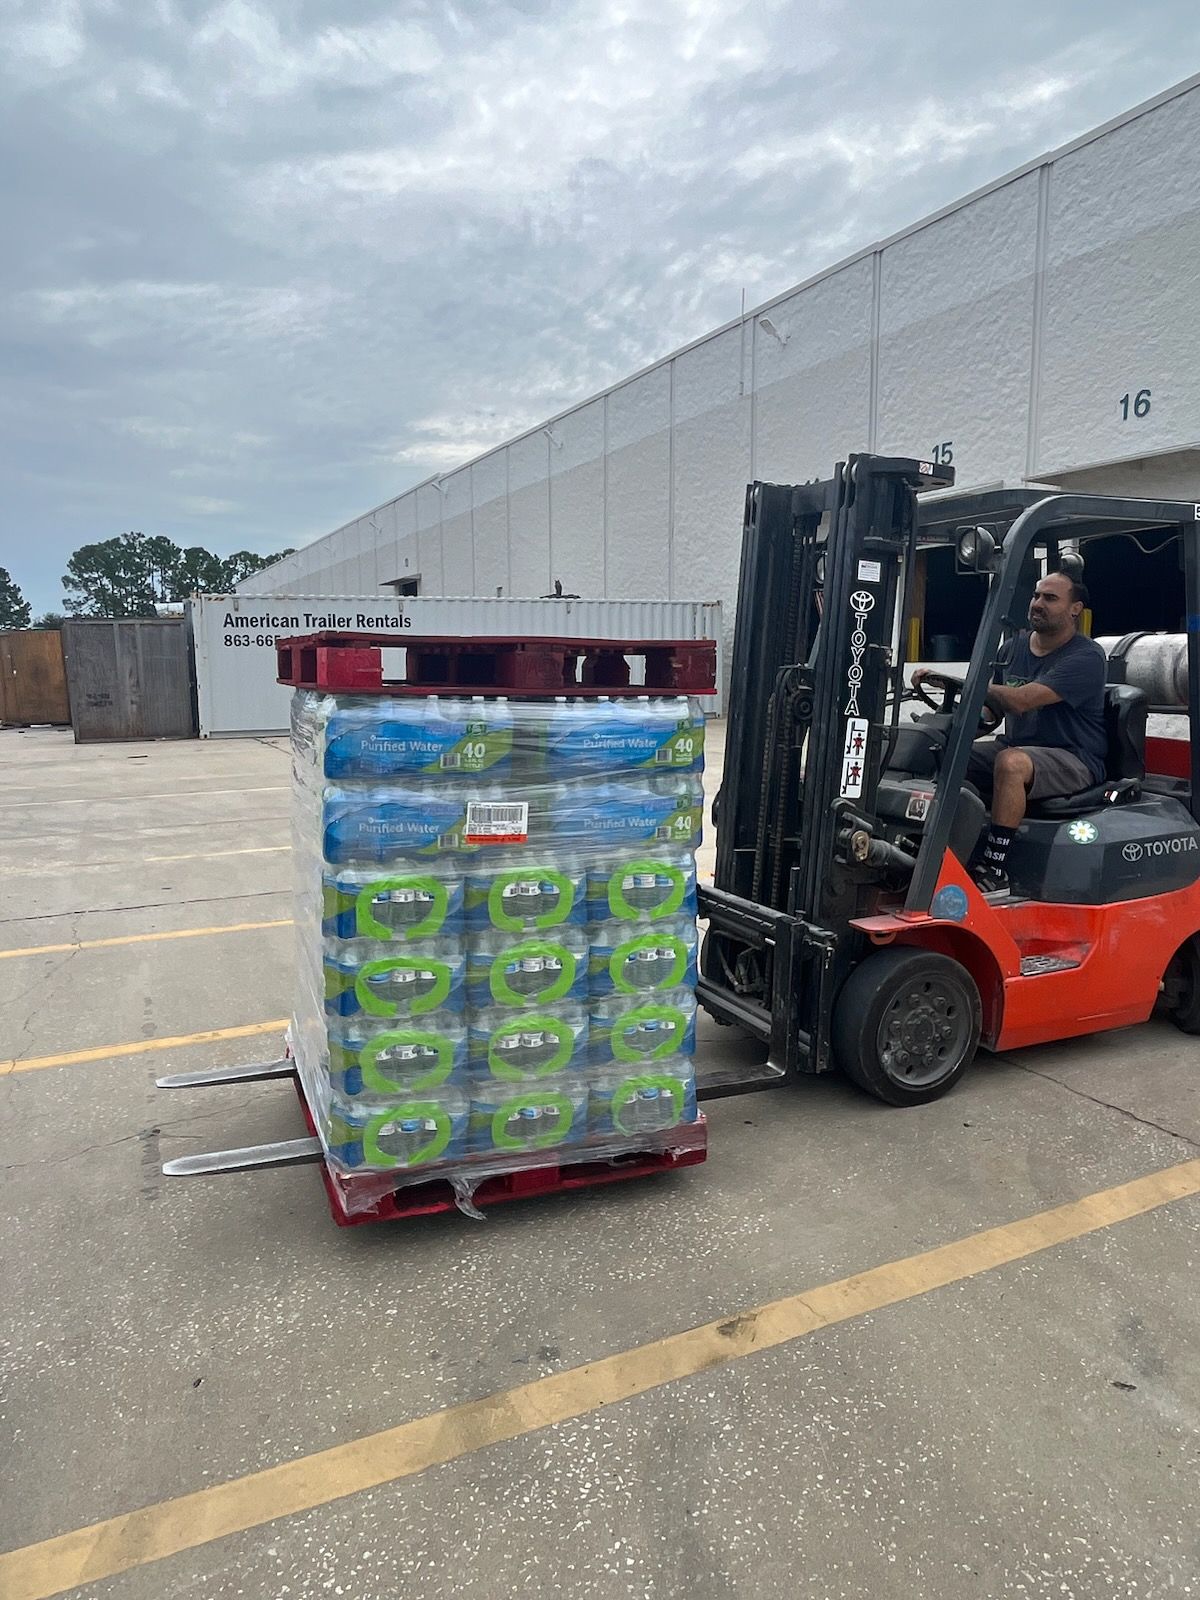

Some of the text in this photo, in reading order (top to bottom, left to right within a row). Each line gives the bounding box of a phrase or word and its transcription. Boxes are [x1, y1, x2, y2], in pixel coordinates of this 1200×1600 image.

[1119, 389, 1152, 421] 16
[931, 441, 954, 465] 15
[223, 613, 412, 628] American Trailer Rentals
[844, 612, 868, 716] TOYOTA
[360, 740, 443, 753] Purified Water
[463, 742, 486, 758] 40
[675, 738, 694, 753] 40
[359, 822, 440, 834] Purified Water
[674, 816, 692, 831] 40
[1143, 836, 1199, 857] TOYOTA
